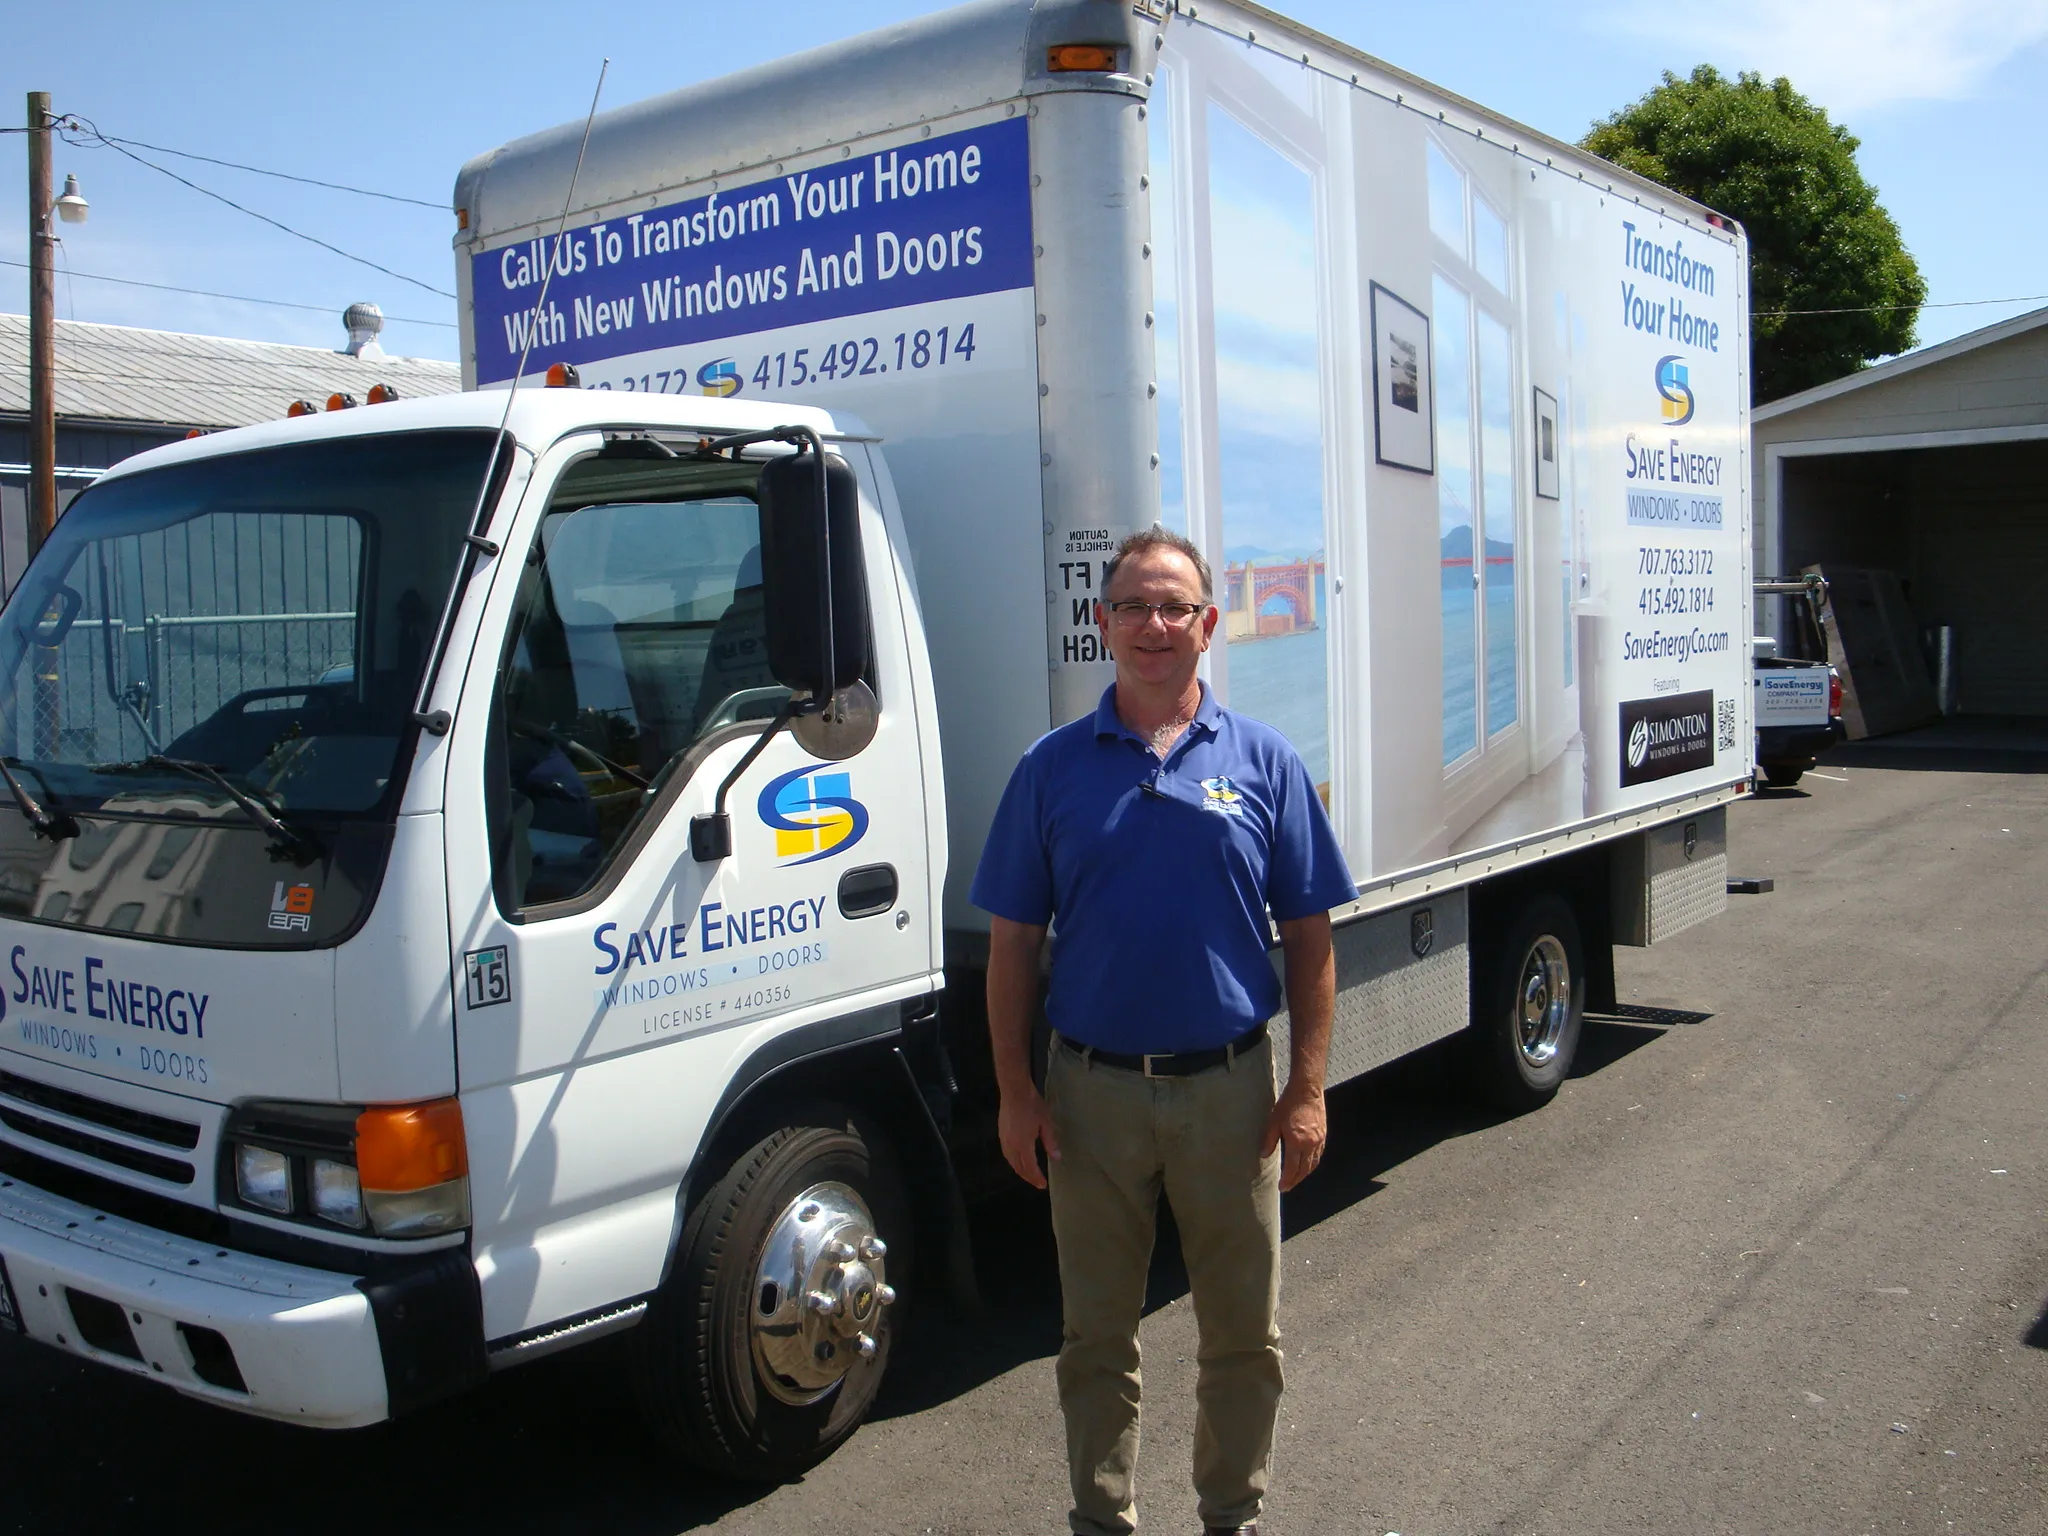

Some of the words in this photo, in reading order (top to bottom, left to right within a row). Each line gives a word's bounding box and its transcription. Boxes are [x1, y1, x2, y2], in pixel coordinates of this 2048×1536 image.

[500, 238, 546, 290] Call
[554, 230, 586, 276] Us
[591, 223, 623, 267] To
[627, 193, 780, 258] Transform
[787, 170, 865, 221] Your
[874, 144, 981, 202] Home
[1622, 220, 1715, 297] Transform
[504, 303, 566, 355] With
[574, 294, 633, 340] New
[642, 263, 787, 325] Windows
[796, 235, 863, 297] And
[876, 225, 983, 276] Doors
[1621, 280, 1666, 336] Your
[1669, 297, 1719, 353] Home
[752, 323, 976, 391] 415.492.1814
[1626, 432, 1665, 481] SAVE
[1669, 438, 1722, 486] ENERGY
[1628, 494, 1680, 521] WINDOWS
[1691, 500, 1722, 524] DOORS
[1638, 547, 1714, 575] 707.763.3172
[1639, 587, 1714, 615] 415.492.1814
[1624, 627, 1729, 663] SaveEnergyCo.com
[1653, 678, 1680, 692] Featuring
[1767, 681, 1822, 690] SaveEnergy
[1649, 713, 1707, 745] SIMONTON
[1649, 744, 1680, 760] WINDOWS
[1688, 739, 1707, 752] DOORS
[268, 912, 311, 931] EFI
[594, 921, 688, 975] SAVE
[700, 895, 827, 952] ENERGY
[10, 945, 77, 1014] SAVE
[85, 956, 209, 1039] ENERGY
[471, 961, 505, 1001] 15
[602, 968, 709, 1009] WINDOWS
[758, 944, 823, 974] DOORS
[643, 1002, 712, 1034] LICENSE
[734, 986, 792, 1012] 440356
[20, 1017, 97, 1058] WINDOWS
[140, 1046, 208, 1085] DOORS
